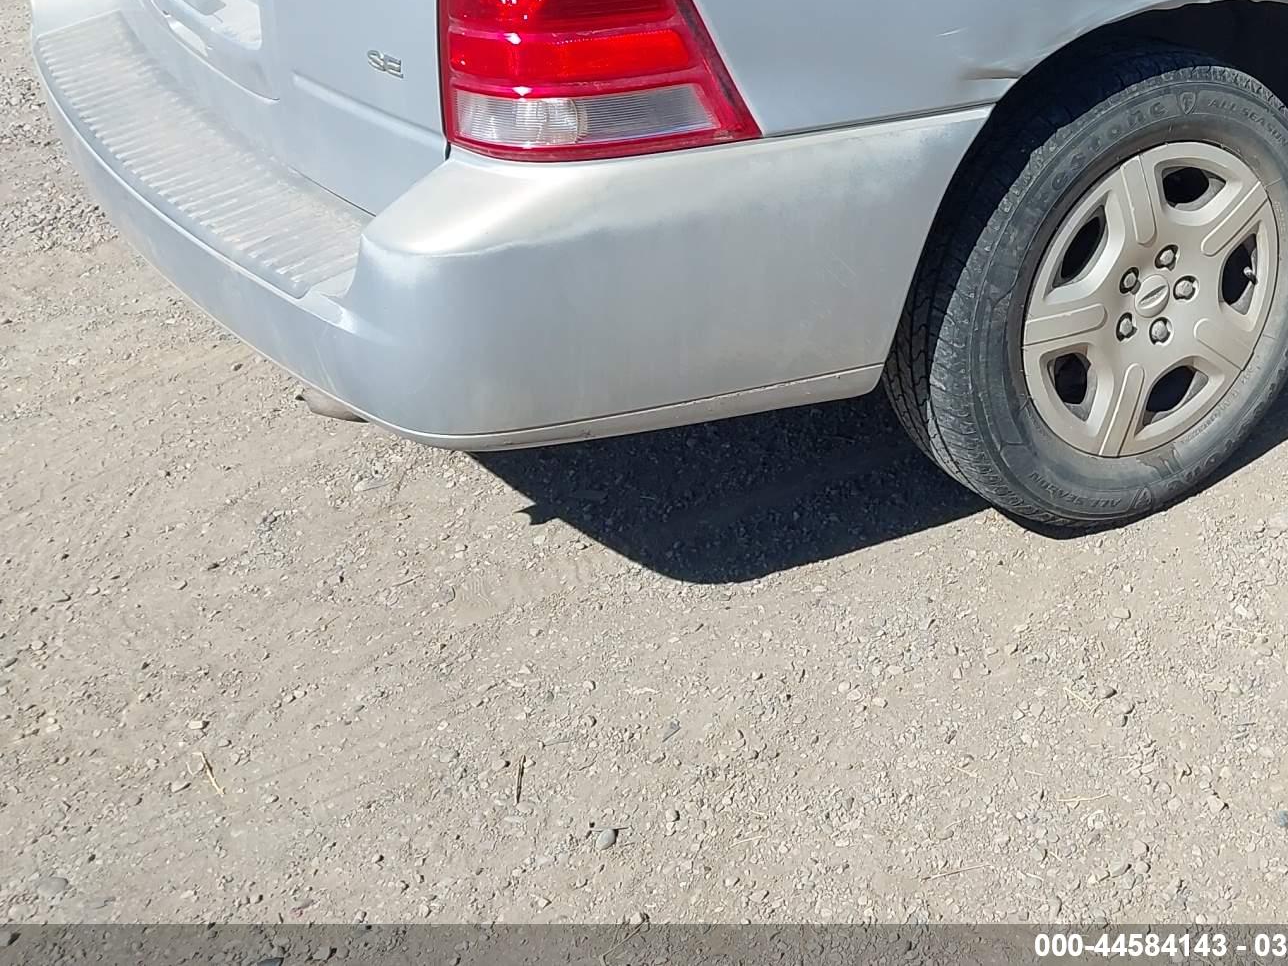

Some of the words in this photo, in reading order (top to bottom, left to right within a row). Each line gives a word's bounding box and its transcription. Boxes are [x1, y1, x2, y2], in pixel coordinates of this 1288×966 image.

[367, 49, 404, 79] SE
[1207, 97, 1237, 112] ALL
[1241, 107, 1288, 147] SEASON
[1028, 471, 1086, 507] SEASON
[1090, 497, 1122, 508] ALL
